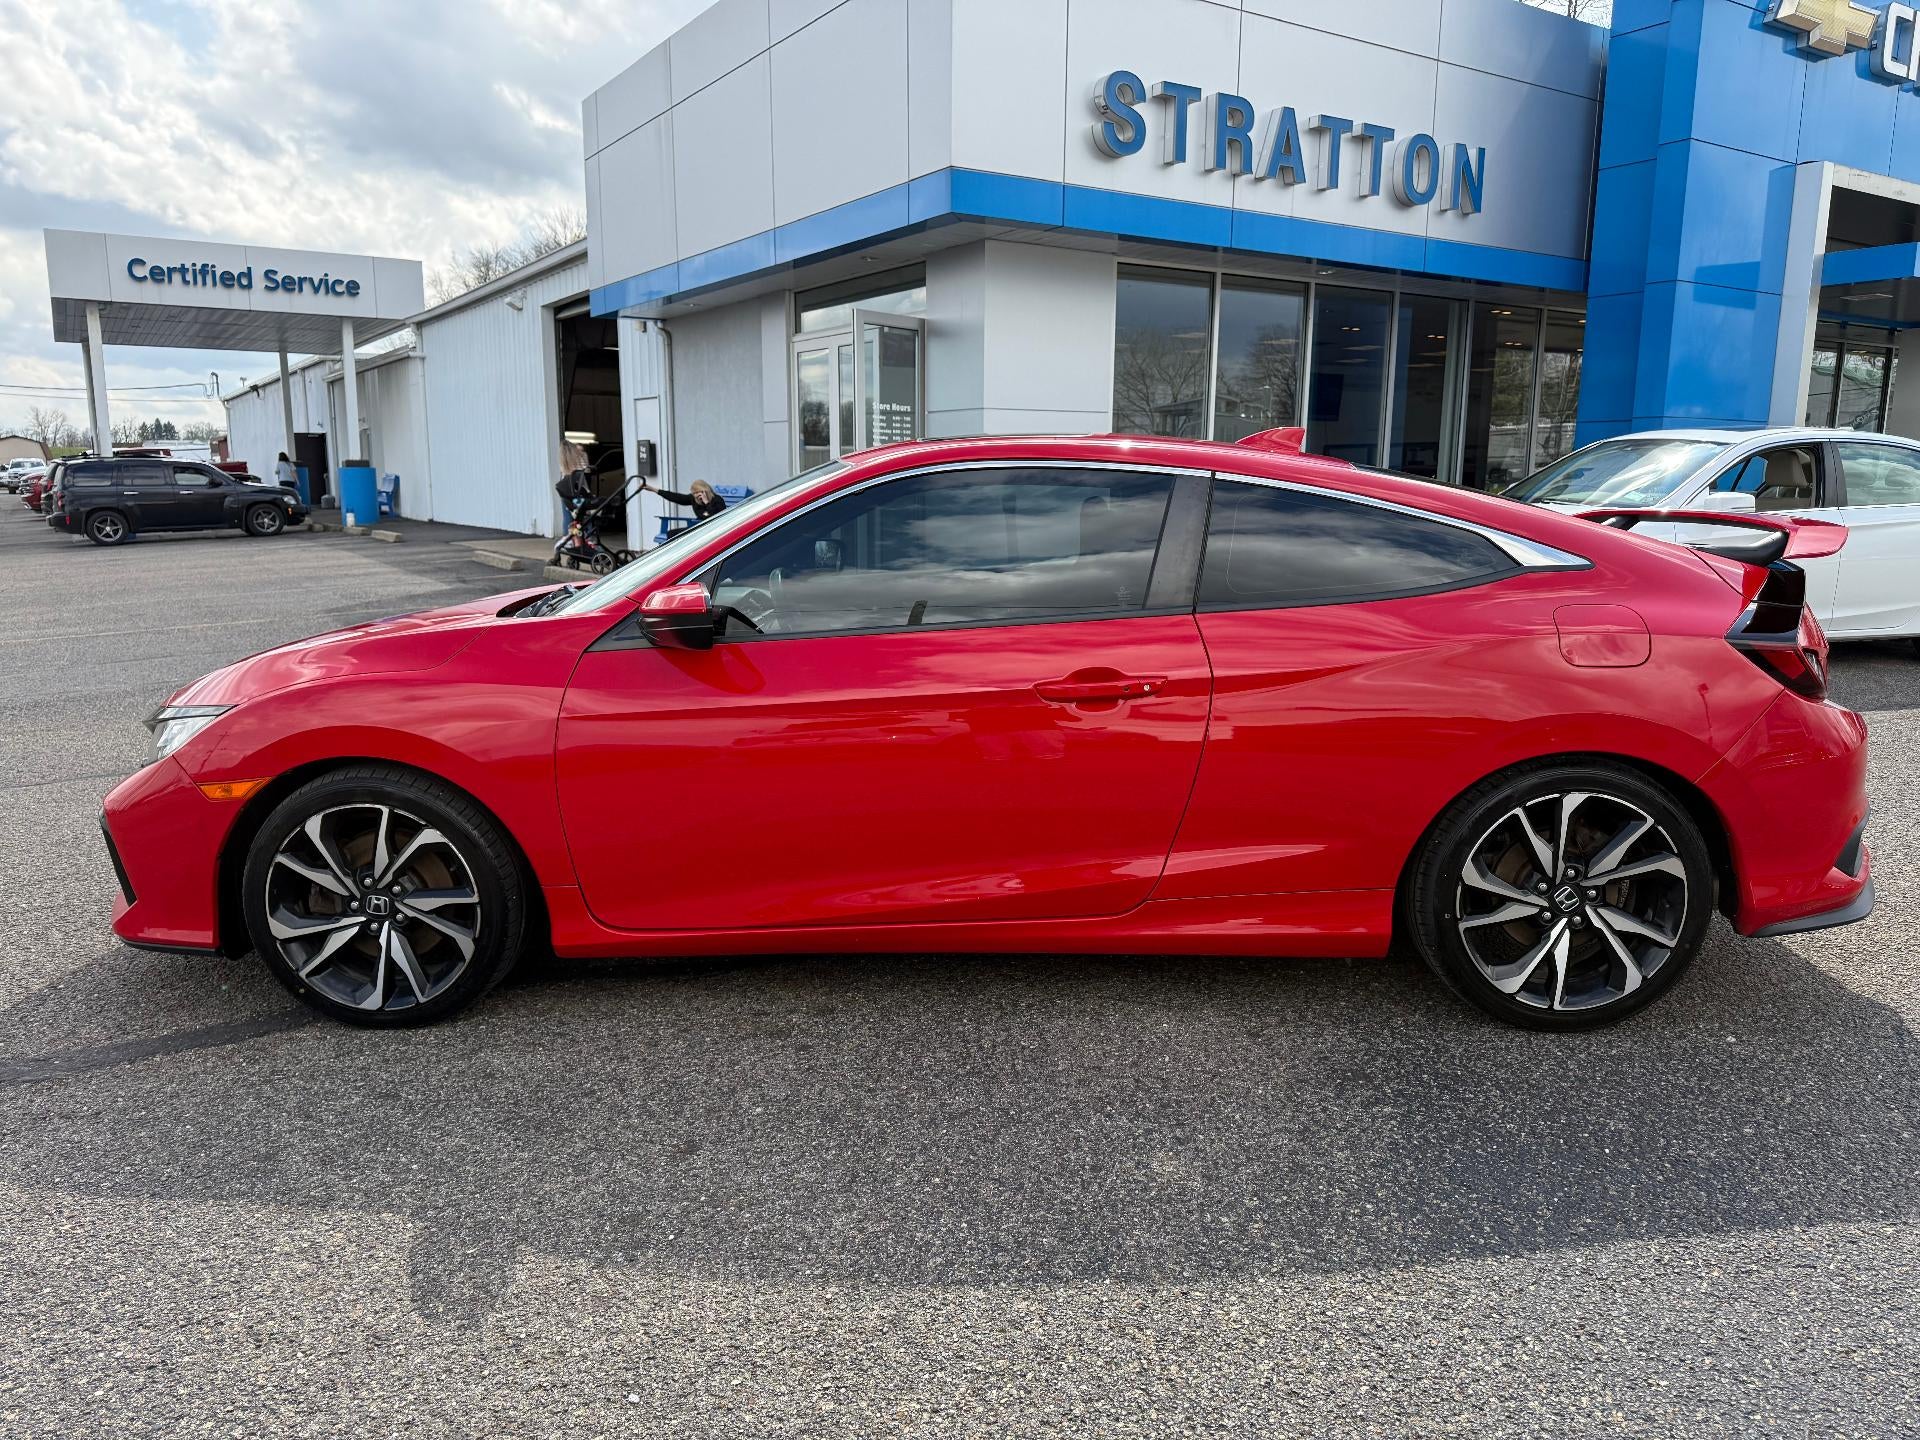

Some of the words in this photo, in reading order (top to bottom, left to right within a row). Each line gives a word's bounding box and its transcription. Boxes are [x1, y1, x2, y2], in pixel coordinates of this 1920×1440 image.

[1093, 70, 1486, 215] STRATTON
[127, 258, 253, 290] Certified
[263, 269, 361, 298] Service
